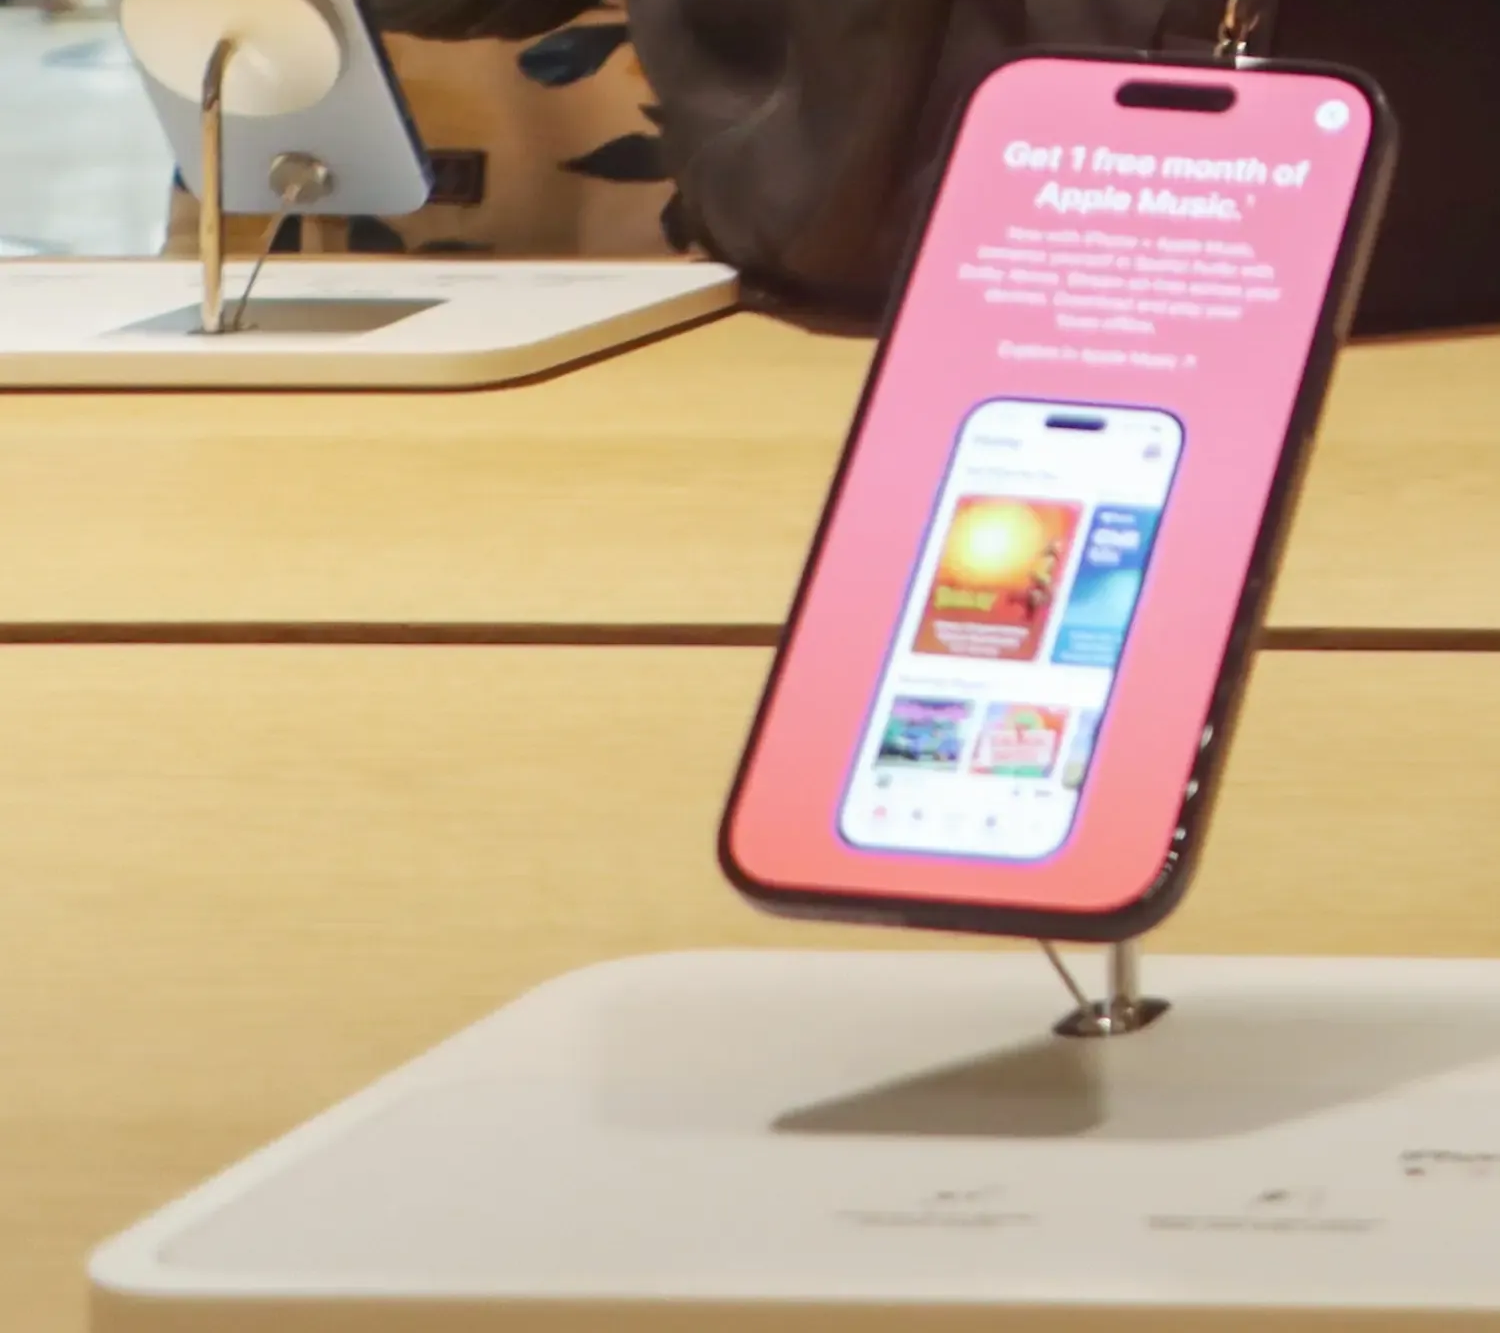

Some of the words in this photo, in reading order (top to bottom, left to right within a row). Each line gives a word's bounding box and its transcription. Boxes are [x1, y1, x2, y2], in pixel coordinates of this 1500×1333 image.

[1003, 140, 1062, 172] Get
[1072, 144, 1086, 172] 1
[1092, 145, 1156, 177] free
[1162, 155, 1267, 184] month
[1272, 158, 1311, 189] of
[1034, 180, 1131, 215] Apple
